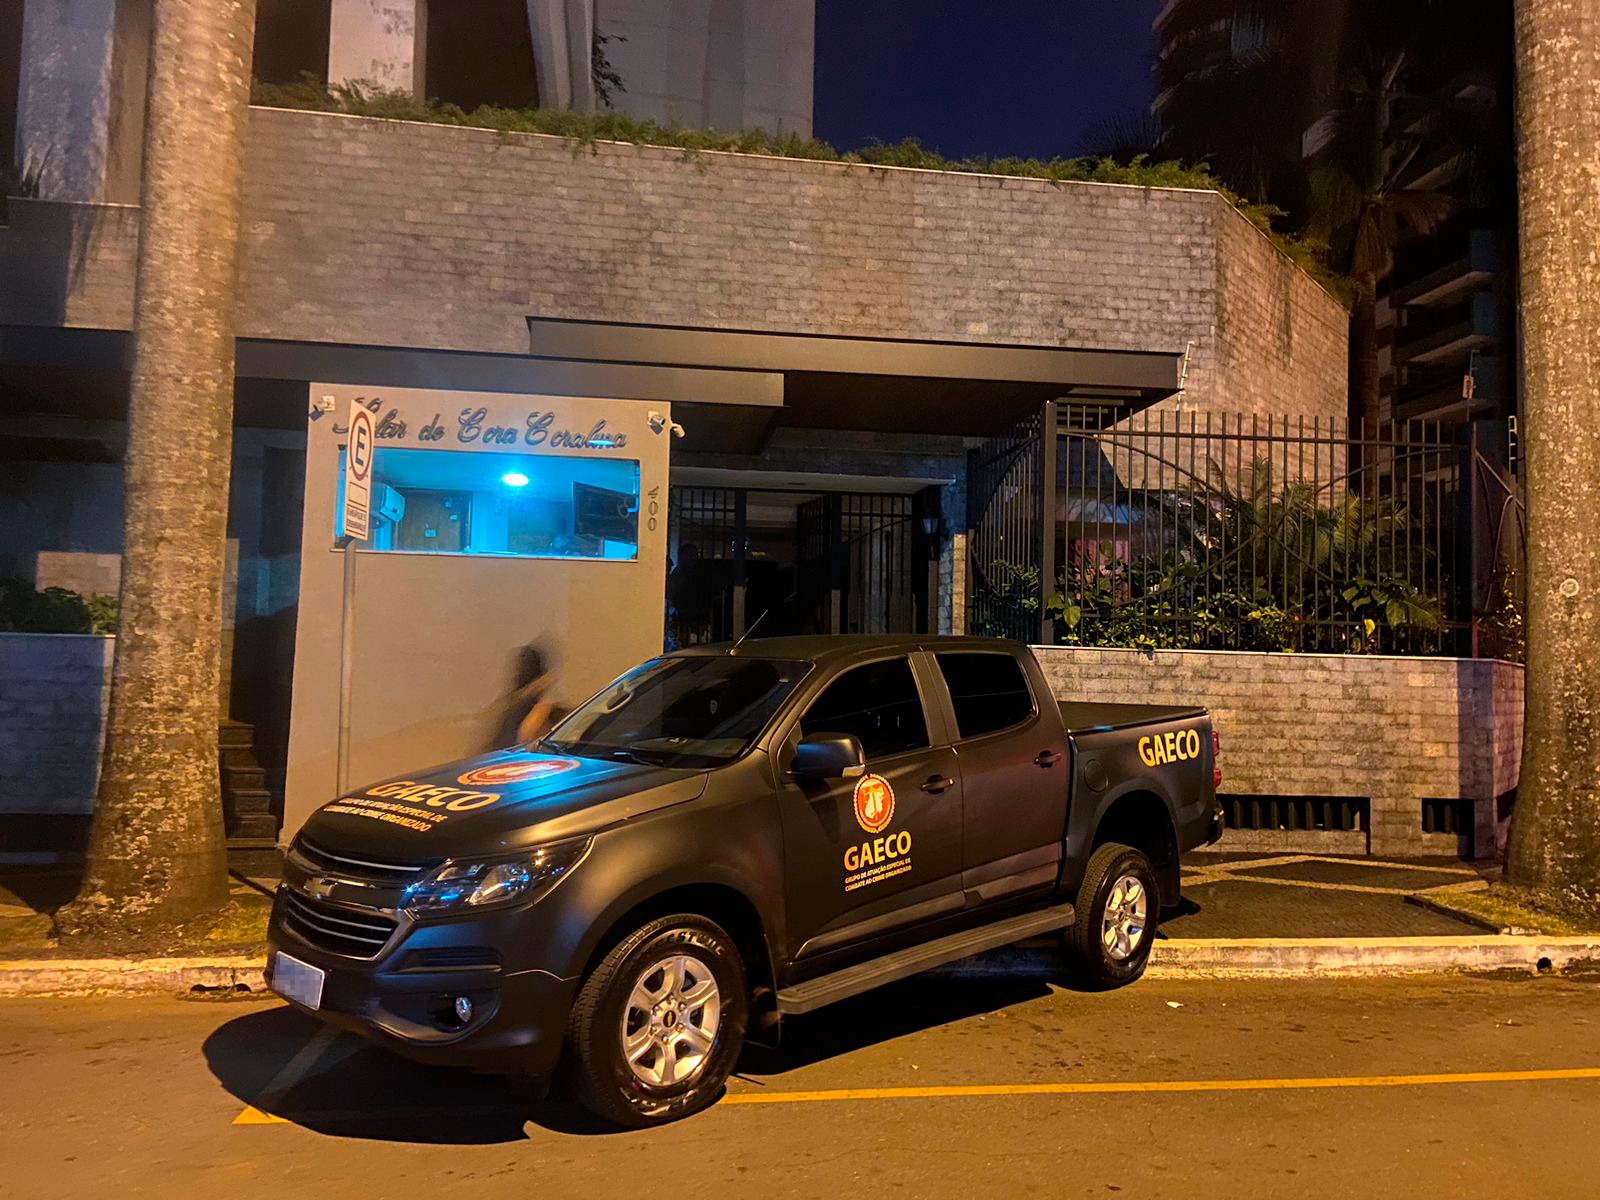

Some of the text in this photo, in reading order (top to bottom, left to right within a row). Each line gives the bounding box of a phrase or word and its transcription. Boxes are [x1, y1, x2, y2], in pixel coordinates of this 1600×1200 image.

[332, 397, 407, 439] Slar
[418, 413, 446, 441] de
[457, 407, 519, 445] Cora
[355, 425, 366, 467] E
[647, 485, 659, 531] 400
[1138, 729, 1200, 767] GAECO
[366, 780, 501, 811] GAECO
[844, 831, 912, 871] GAECO
